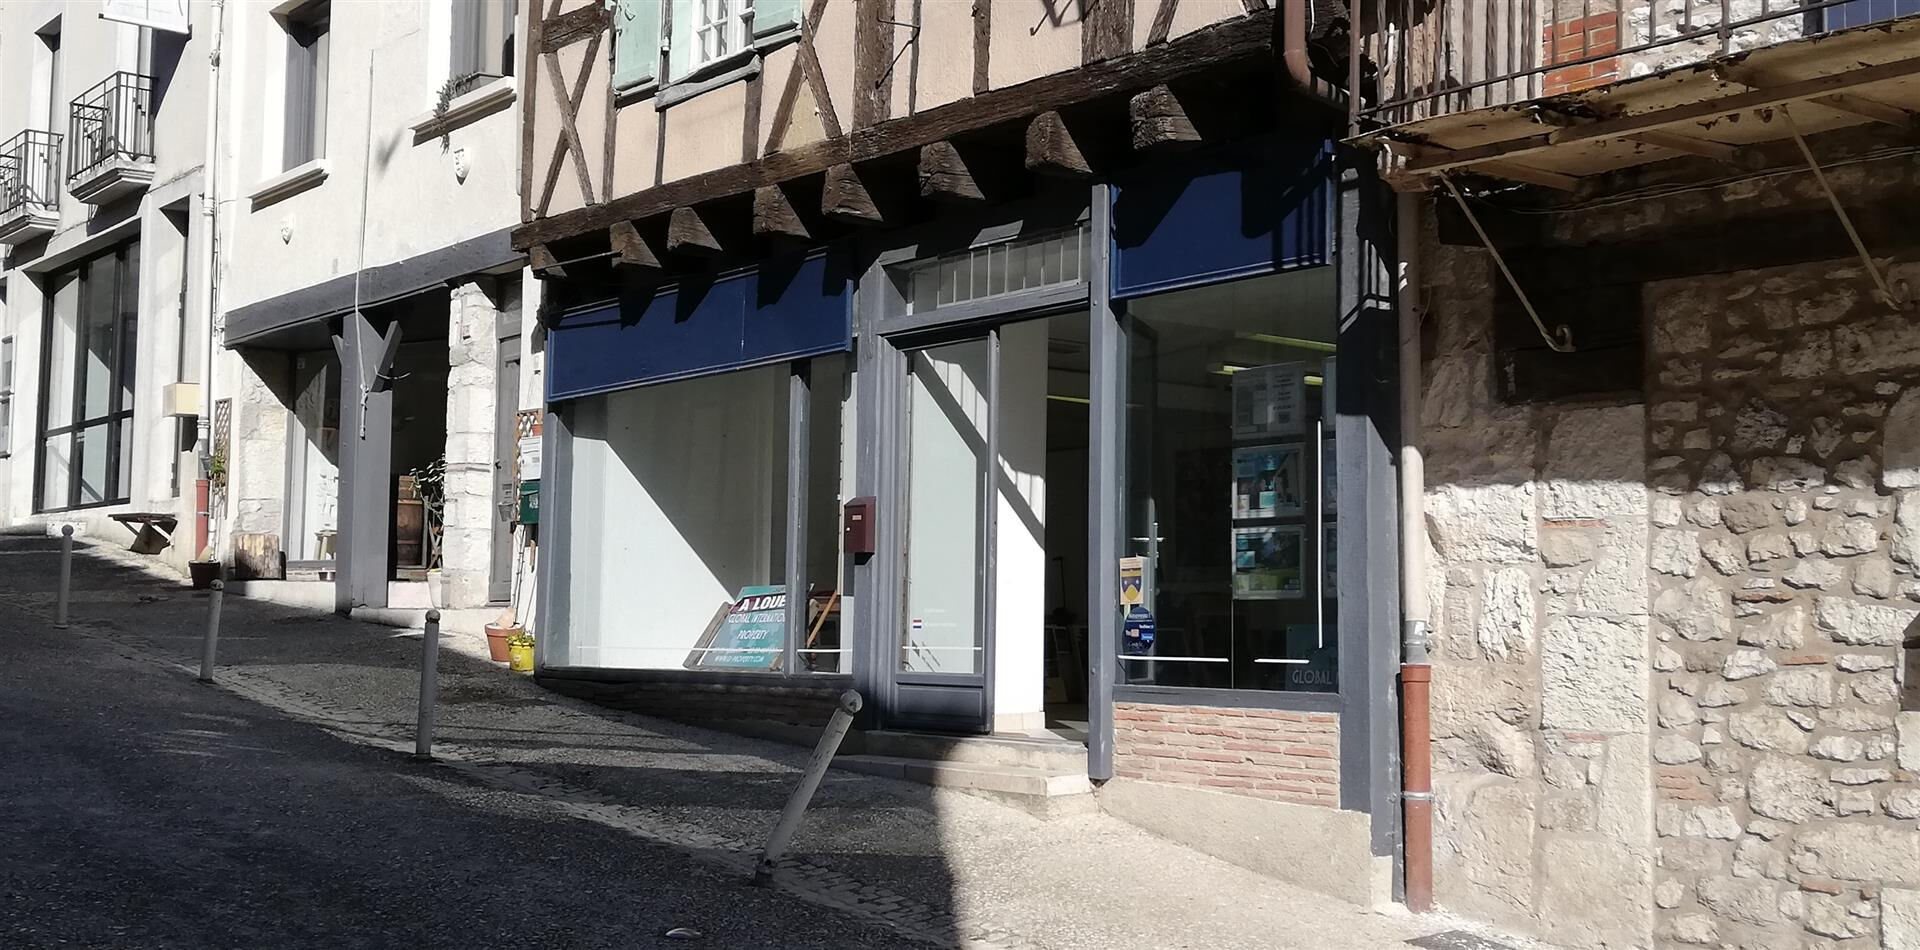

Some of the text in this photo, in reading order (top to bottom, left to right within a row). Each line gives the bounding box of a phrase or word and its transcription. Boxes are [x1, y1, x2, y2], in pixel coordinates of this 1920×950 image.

[738, 598, 750, 612] A
[751, 612, 785, 623] INTERNATIO
[1292, 669, 1333, 685] GLOBAL
